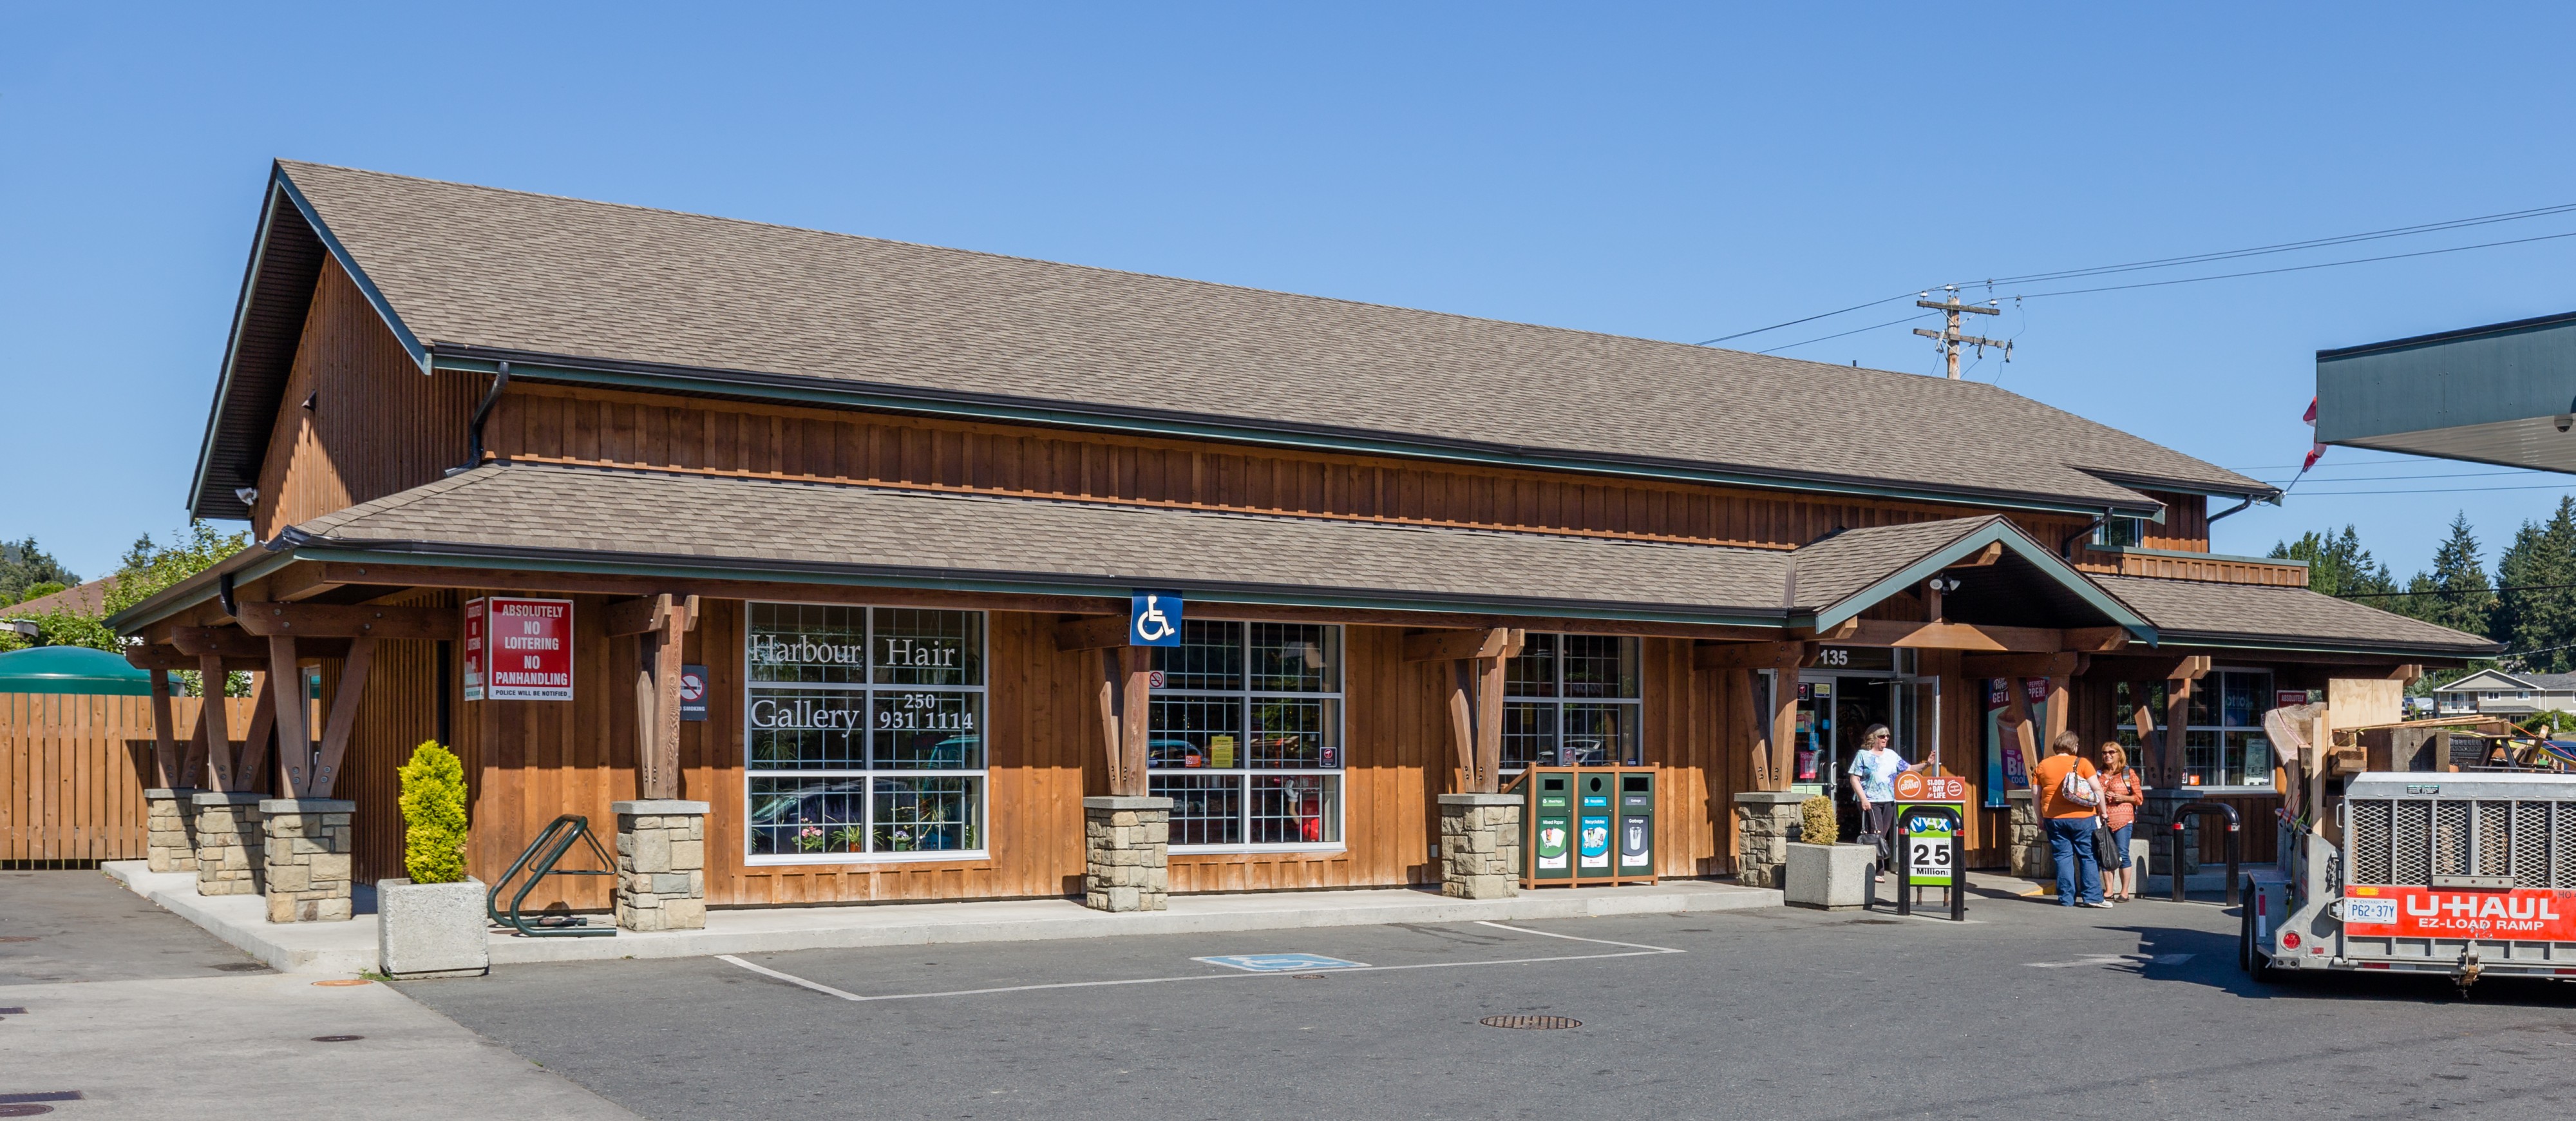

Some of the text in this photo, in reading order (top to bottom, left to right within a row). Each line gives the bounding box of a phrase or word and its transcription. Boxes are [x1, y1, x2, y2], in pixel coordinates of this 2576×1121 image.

[502, 604, 563, 618] ABSOLUTELY
[524, 621, 540, 635] NO
[505, 637, 559, 651] LOITERING
[751, 635, 955, 667] Harbour Hair
[524, 655, 540, 669] NO
[1821, 649, 1848, 666] 135
[495, 672, 567, 685] PANHANDLING
[904, 694, 934, 709] 250
[1993, 687, 2045, 704] GET A PPER!
[751, 700, 860, 738] Gallery
[880, 711, 973, 729] 931 1114
[1900, 781, 1919, 791] GRAND
[2011, 775, 2025, 784] cool
[1910, 817, 1949, 832] MAX
[1913, 844, 1951, 865] 25
[2407, 895, 2560, 920] U-HAUL
[2419, 918, 2544, 931] EZ-LOAD RAMP
